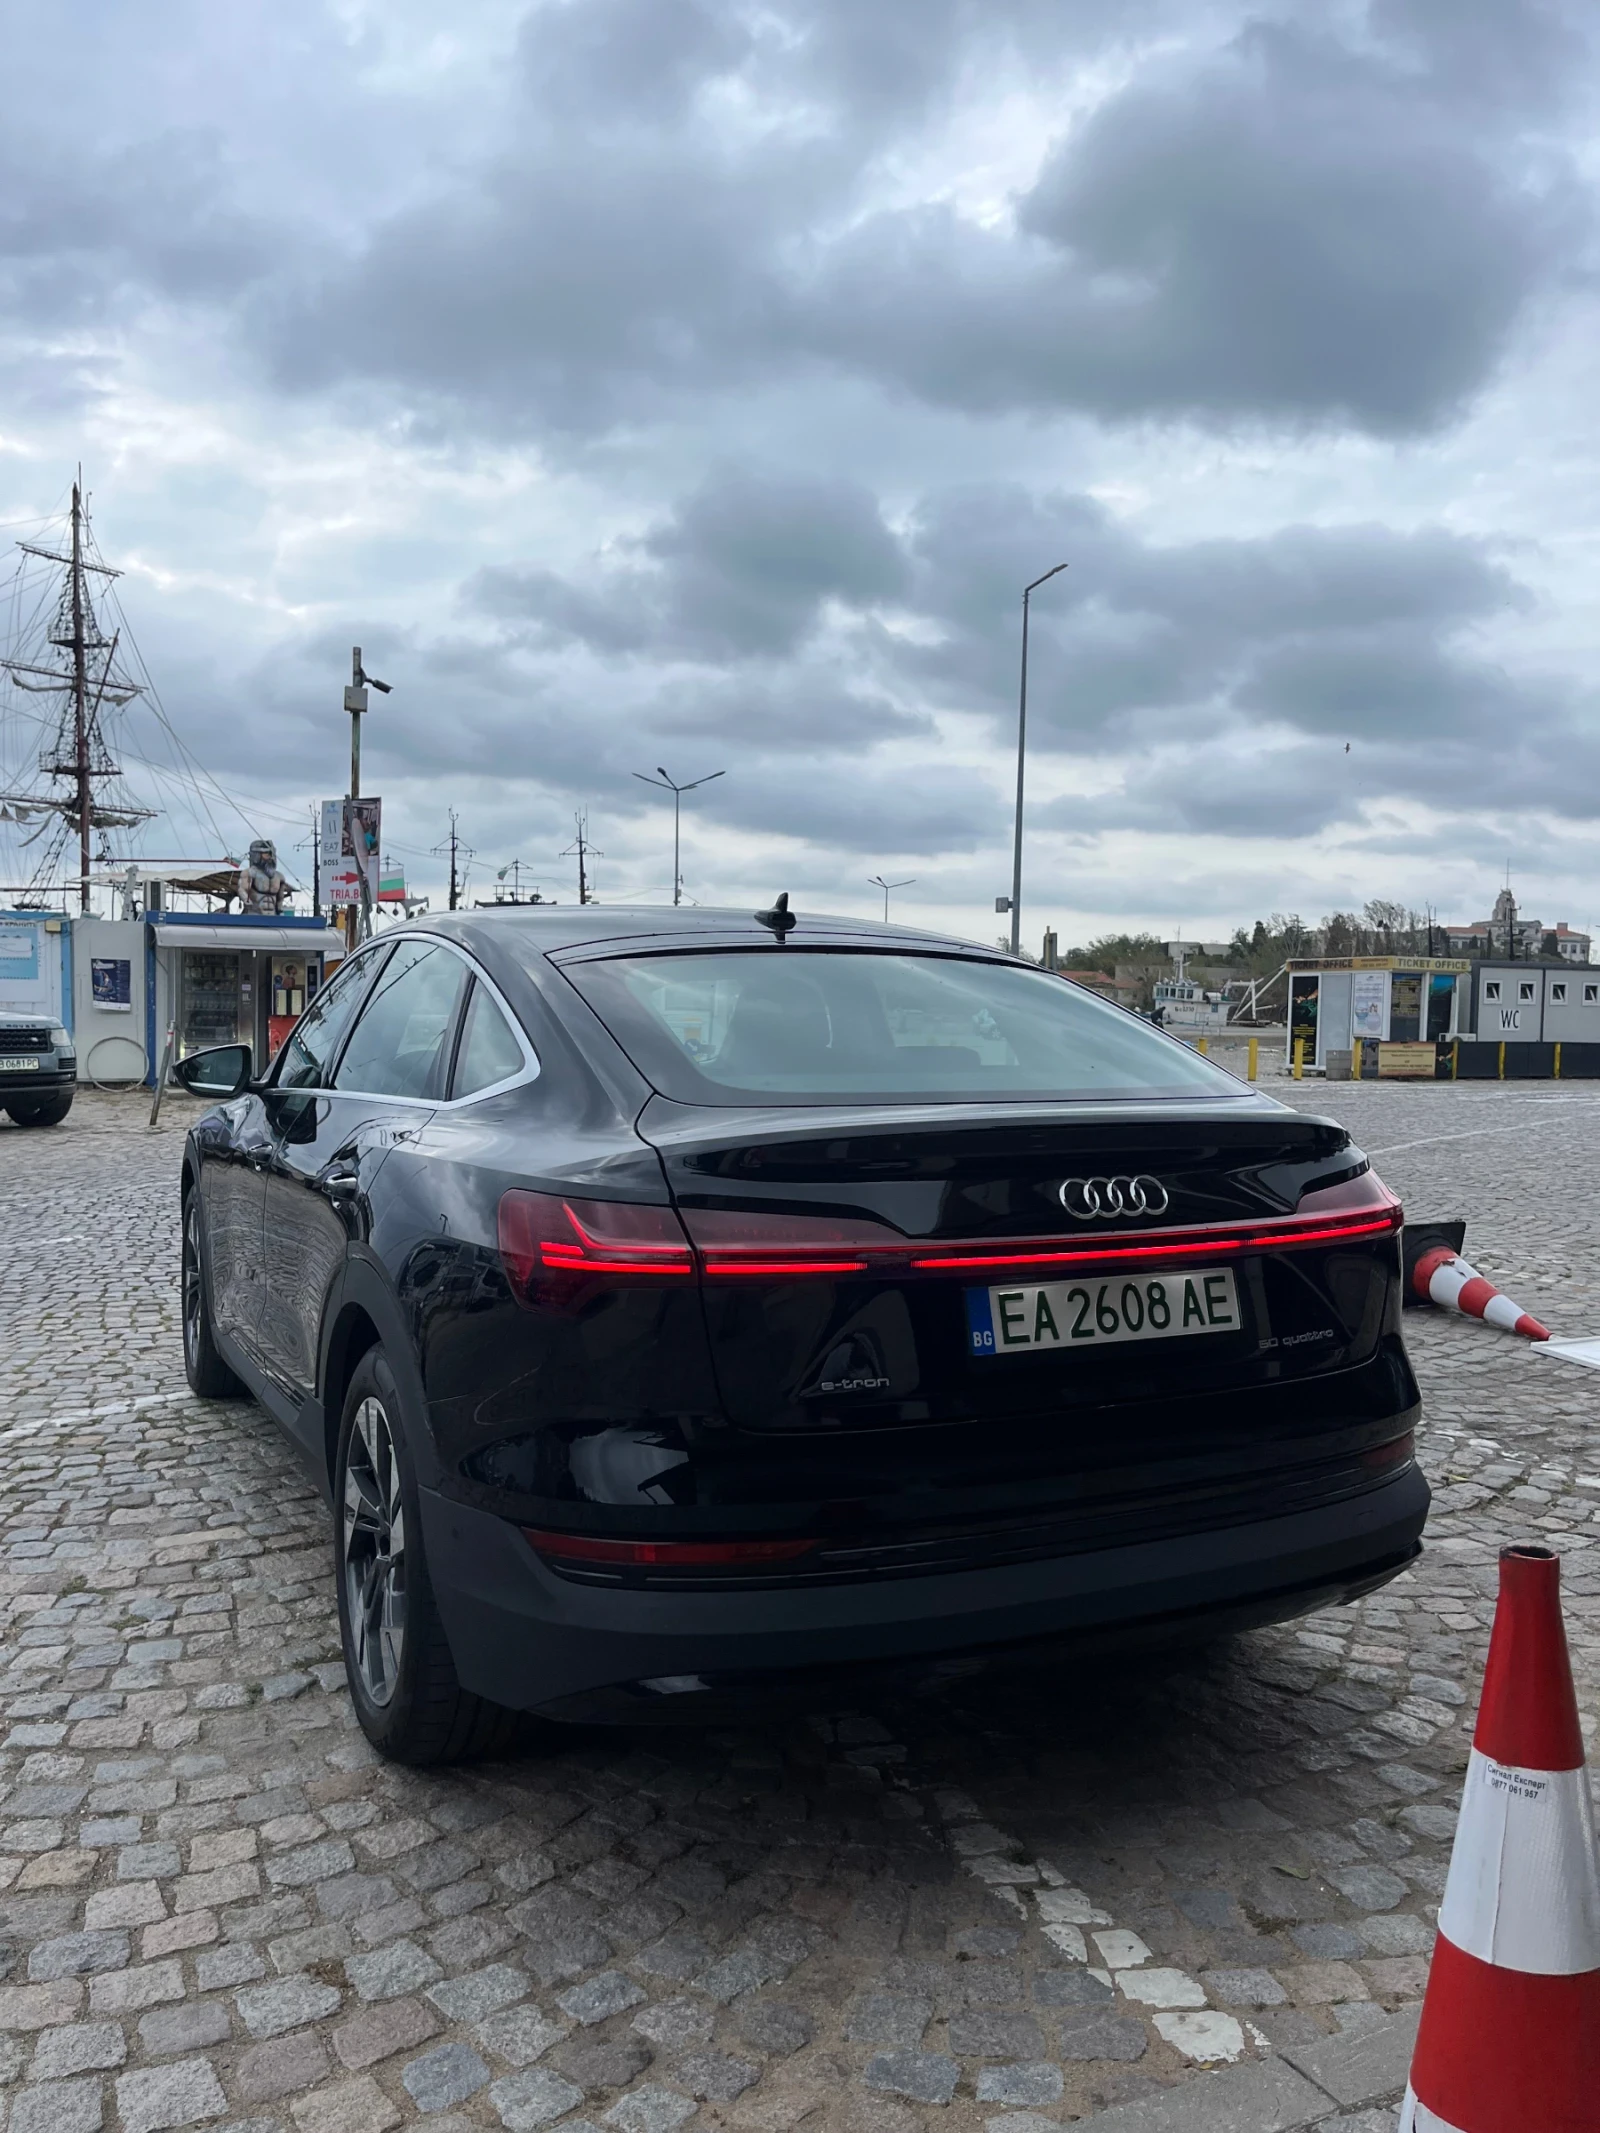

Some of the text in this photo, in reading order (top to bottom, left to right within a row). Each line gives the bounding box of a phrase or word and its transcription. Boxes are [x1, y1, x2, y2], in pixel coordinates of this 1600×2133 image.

[324, 842, 339, 852] EA7
[330, 888, 361, 900] TRIA.B
[1290, 960, 1319, 970] TICKET
[1323, 959, 1353, 968] OFFICE
[1398, 958, 1430, 969] TICKET
[1434, 959, 1467, 970] OFFICE
[1501, 1009, 1520, 1029] WC
[998, 1275, 1233, 1344] EA 2608 AE
[973, 1331, 993, 1348] BG
[1282, 1328, 1334, 1346] quattro
[821, 1377, 890, 1391] e-tron
[1487, 1764, 1546, 1790] Сигнал Експерт
[1490, 1777, 1539, 1799] 0877 061 957
